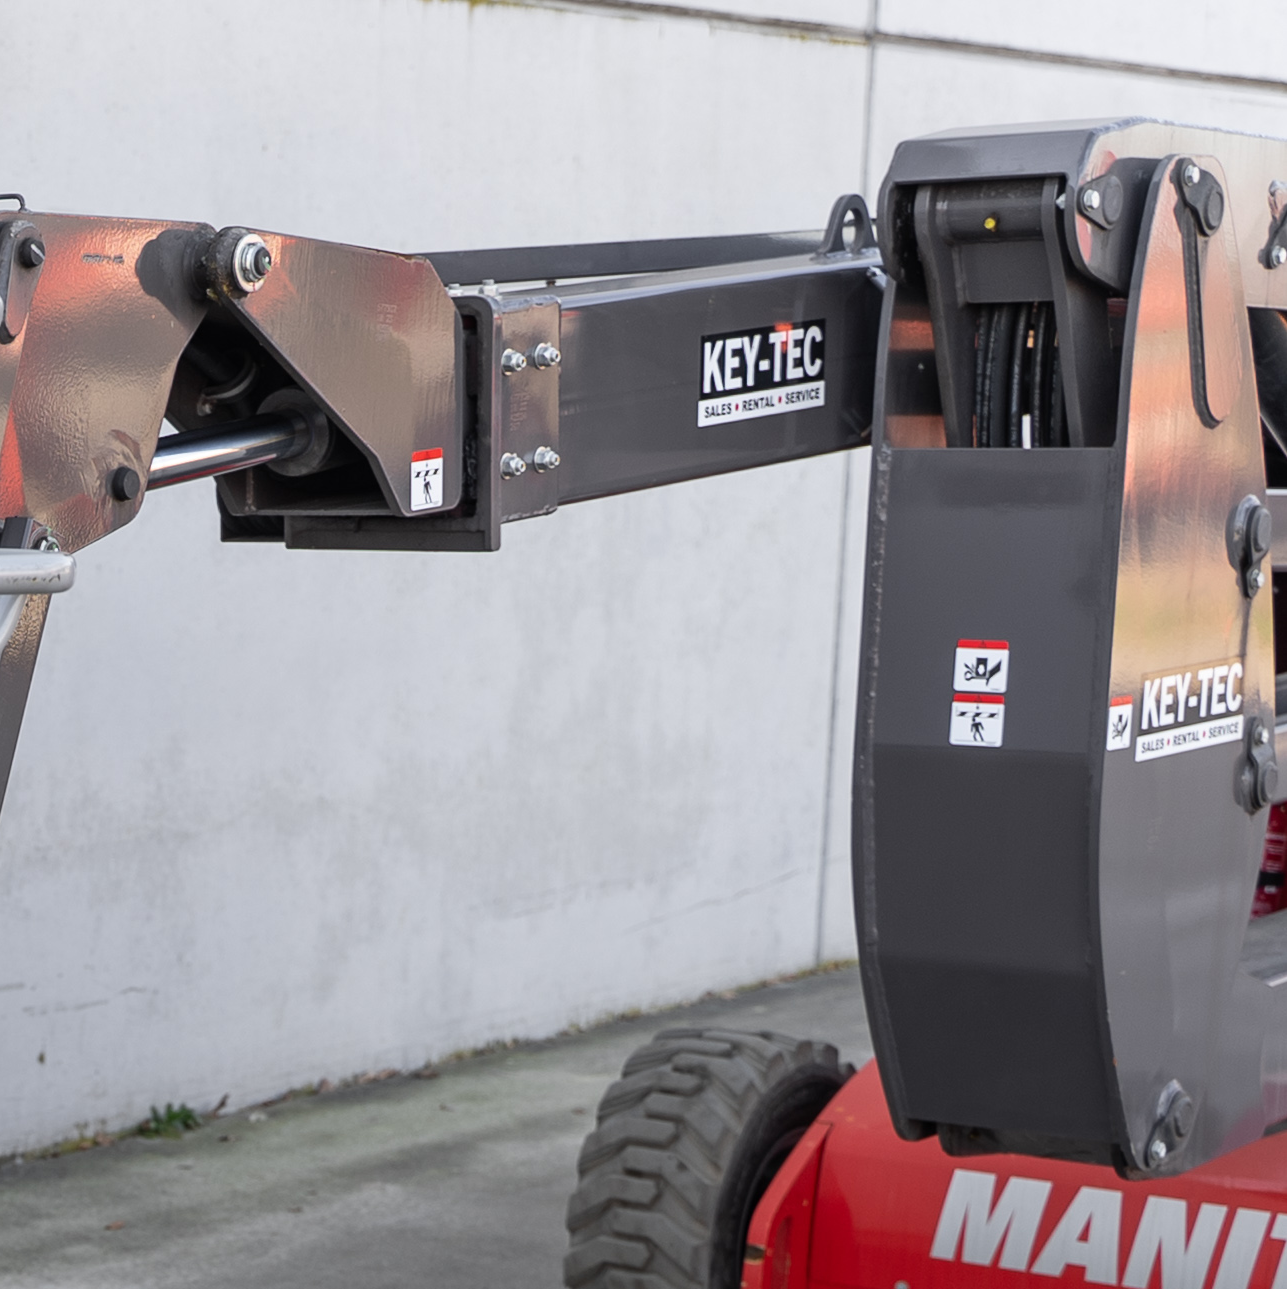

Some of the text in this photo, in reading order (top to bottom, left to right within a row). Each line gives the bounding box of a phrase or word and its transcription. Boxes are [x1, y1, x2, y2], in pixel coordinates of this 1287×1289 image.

[703, 325, 823, 394] KEY-TEC
[704, 387, 820, 419] SALES RENTAL SERVICE
[1141, 662, 1243, 730] KEY-TEC
[1141, 722, 1239, 754] SALES RENTAL SERVICE
